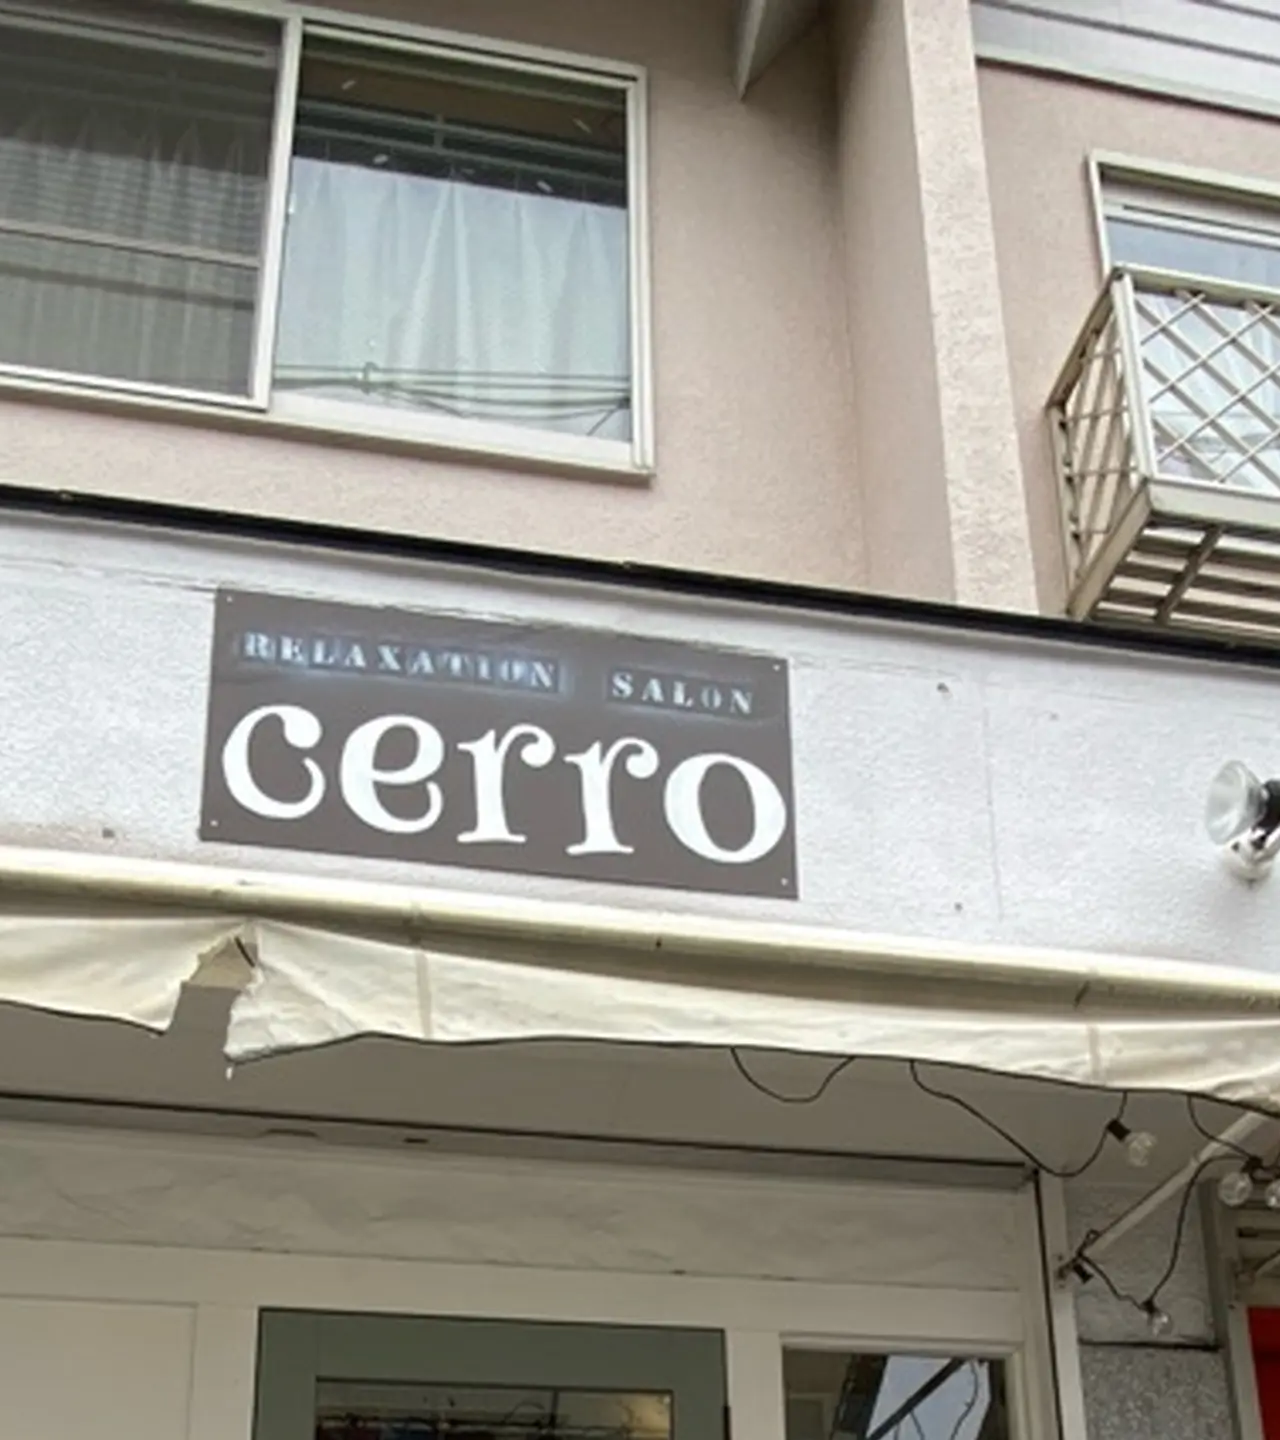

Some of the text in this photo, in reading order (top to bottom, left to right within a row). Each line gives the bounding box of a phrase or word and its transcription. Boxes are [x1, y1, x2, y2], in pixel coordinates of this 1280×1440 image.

[242, 630, 755, 714] RELAXATION SALON
[222, 704, 788, 863] cerro
